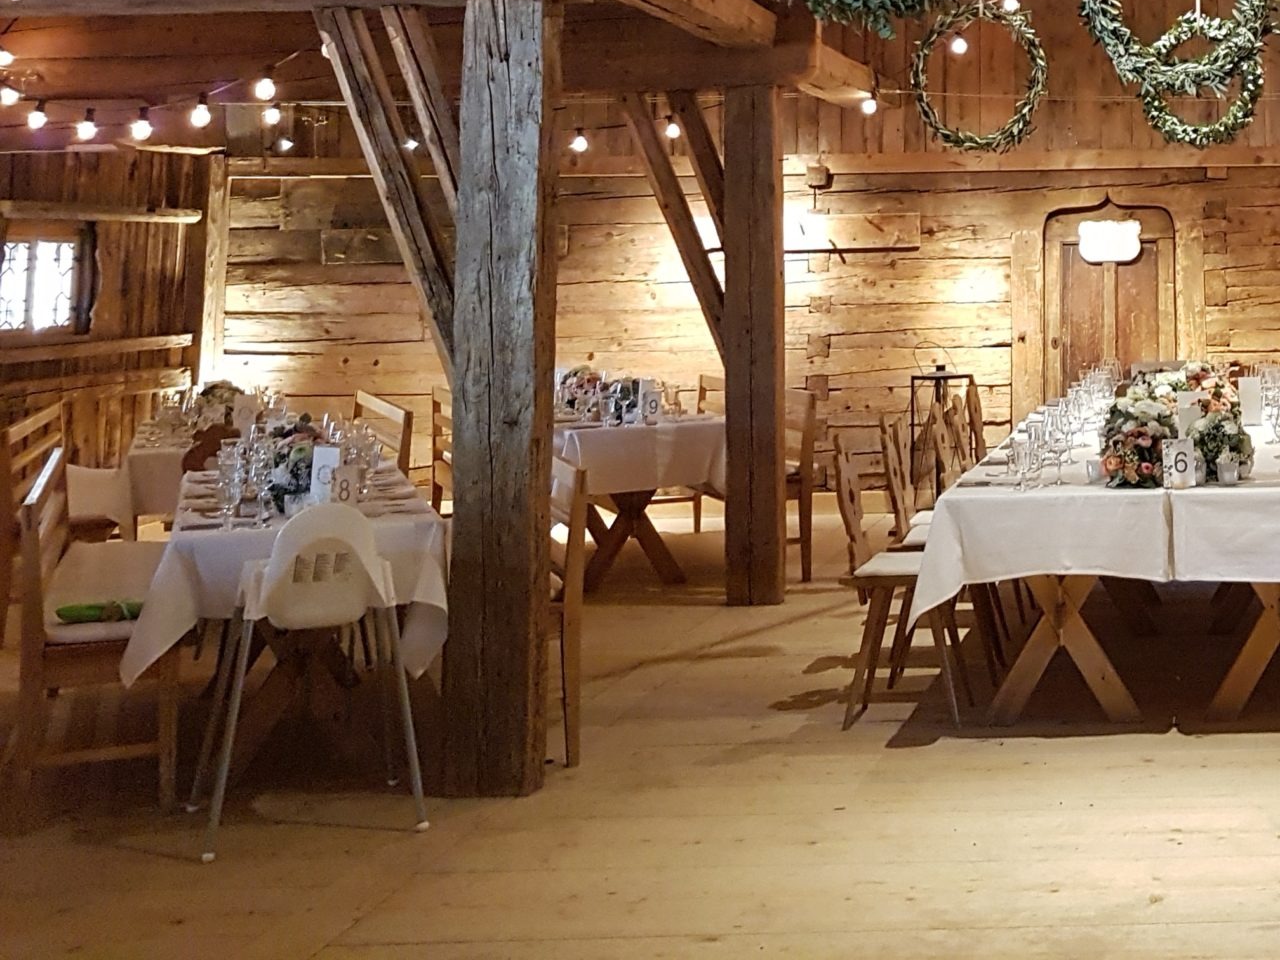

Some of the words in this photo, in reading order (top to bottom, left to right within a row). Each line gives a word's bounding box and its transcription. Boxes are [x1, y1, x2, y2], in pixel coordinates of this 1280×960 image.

[649, 399, 658, 415] 9
[1174, 451, 1188, 473] 6
[339, 479, 351, 501] 8
